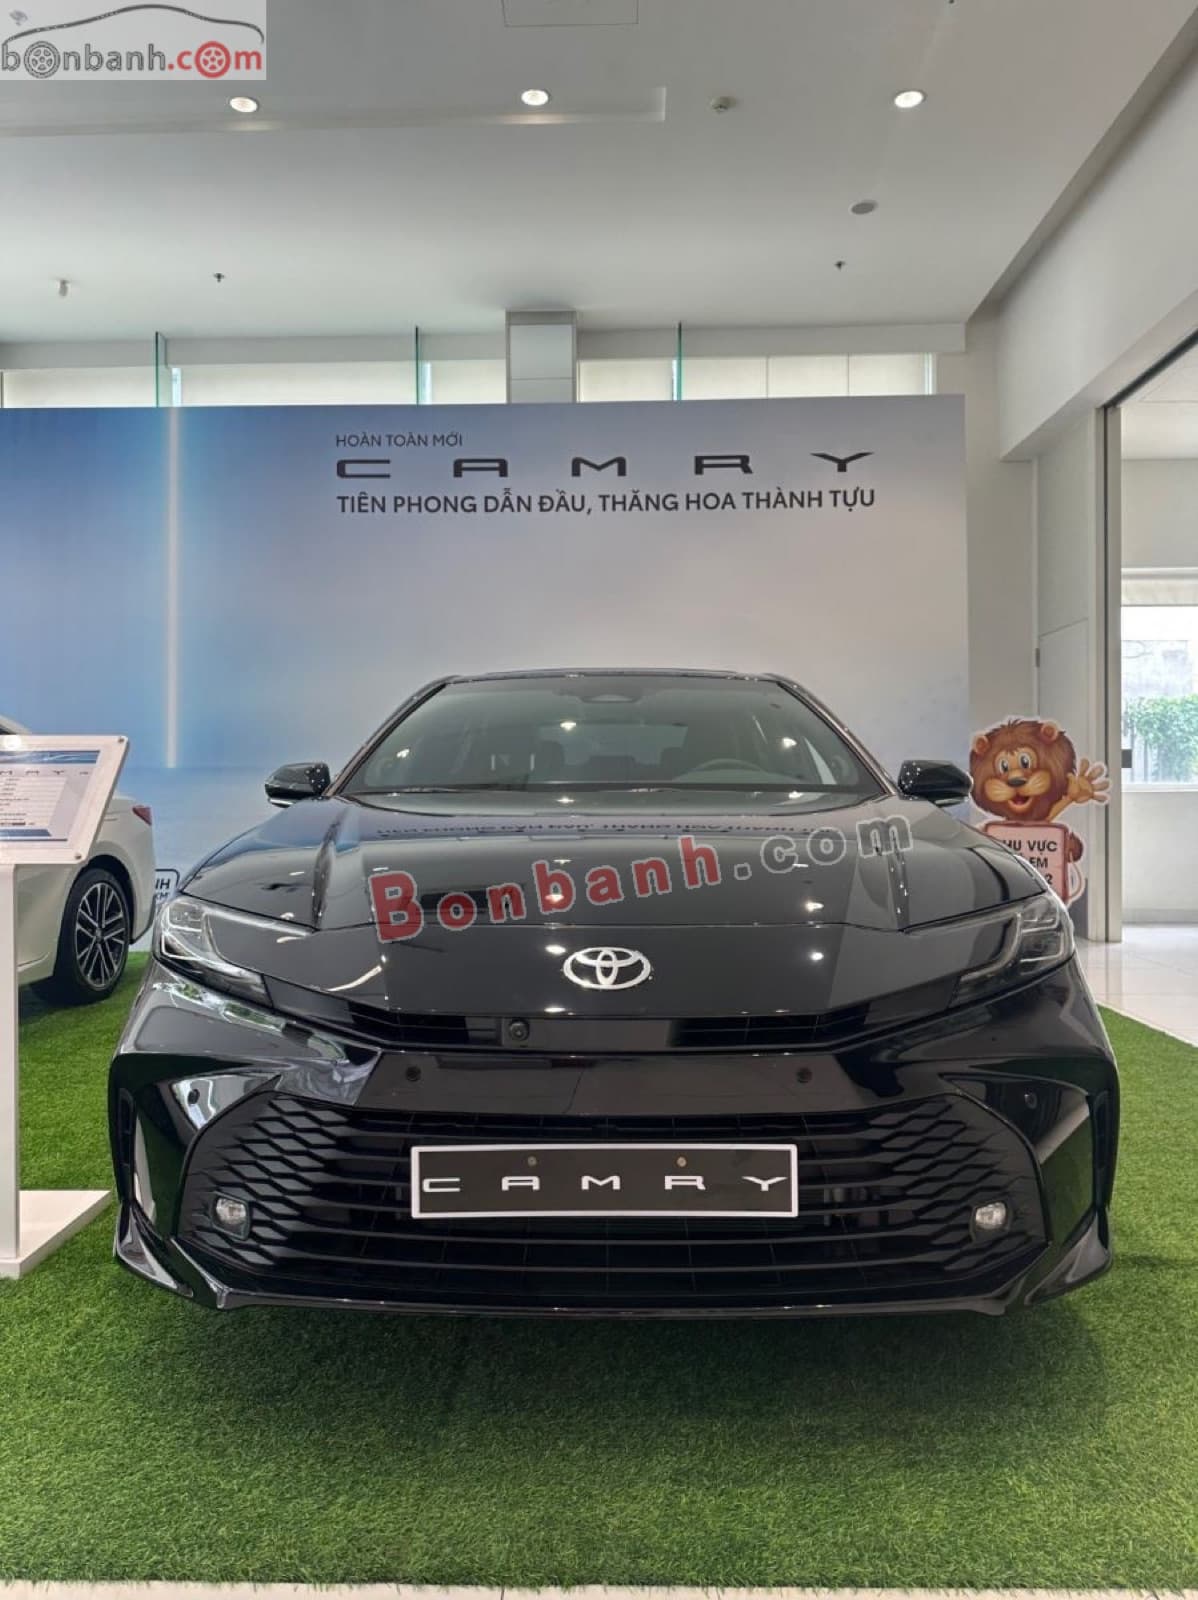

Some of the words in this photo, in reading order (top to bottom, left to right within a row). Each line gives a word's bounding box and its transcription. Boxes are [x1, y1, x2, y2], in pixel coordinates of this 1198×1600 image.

[336, 432, 381, 448] HOÀN
[385, 432, 428, 448] TOÀN
[433, 431, 463, 447] MỚI
[336, 452, 875, 479] CAMRY
[337, 491, 386, 513] TIÊN
[393, 495, 477, 513] PHONG
[484, 487, 532, 513] DẪN
[538, 488, 592, 515] ĐẦU,
[598, 489, 679, 512] THĂNG
[686, 492, 736, 511] HOA
[742, 486, 822, 510] THÀNH
[829, 486, 875, 512] TỰU
[1028, 839, 1057, 855] VỰC
[422, 1175, 787, 1193] CAMRY
